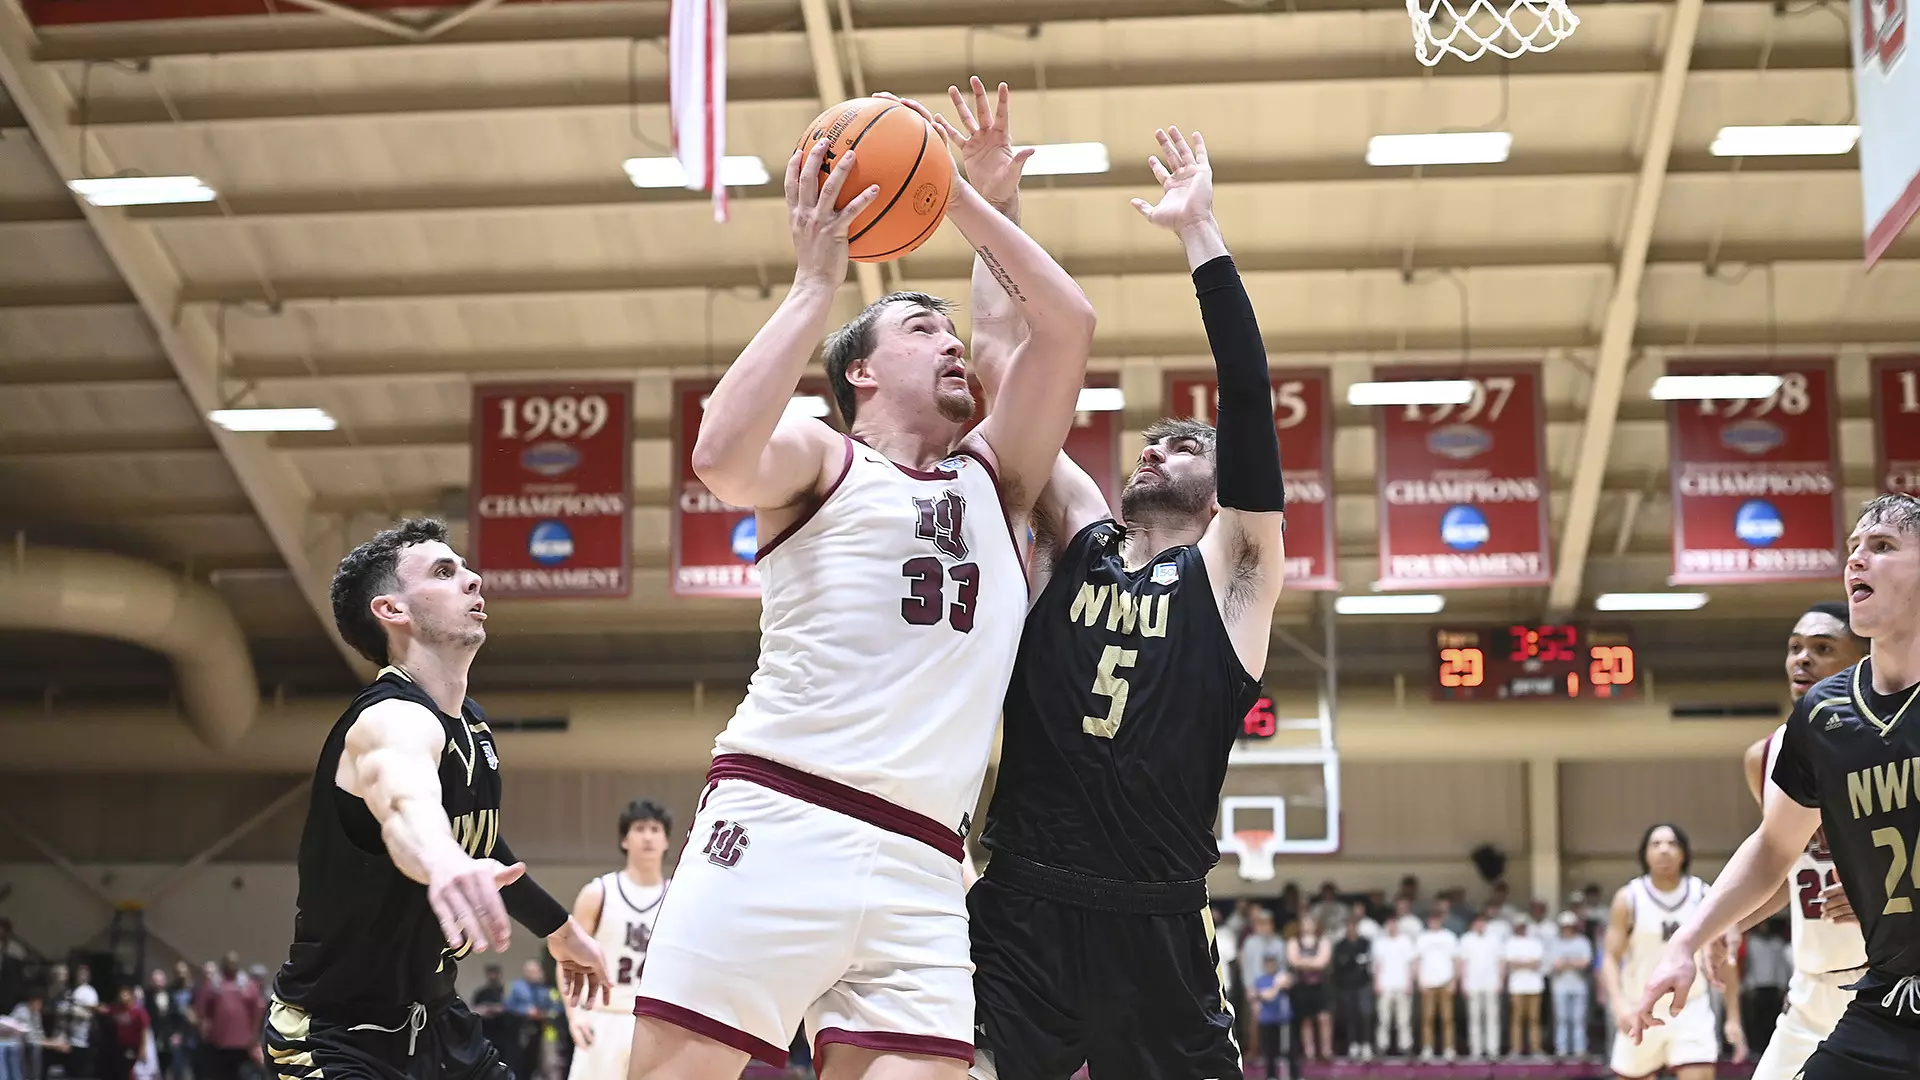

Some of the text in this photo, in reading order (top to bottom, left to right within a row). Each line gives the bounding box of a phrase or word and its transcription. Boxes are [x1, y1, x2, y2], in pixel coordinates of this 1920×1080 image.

[498, 395, 609, 440] 1989
[478, 493, 625, 518] CHAMPIONS
[1384, 479, 1540, 505] CHAMPIONS
[1392, 553, 1539, 578] TOURNAMENT
[901, 557, 980, 634] 33
[1070, 581, 1171, 638] NWU
[1509, 625, 1577, 661] 3:52
[1590, 646, 1634, 685] 20
[1082, 645, 1138, 739] 5
[1871, 826, 1920, 915] 2
[1796, 869, 1834, 919] 2
[618, 957, 645, 983] 2
